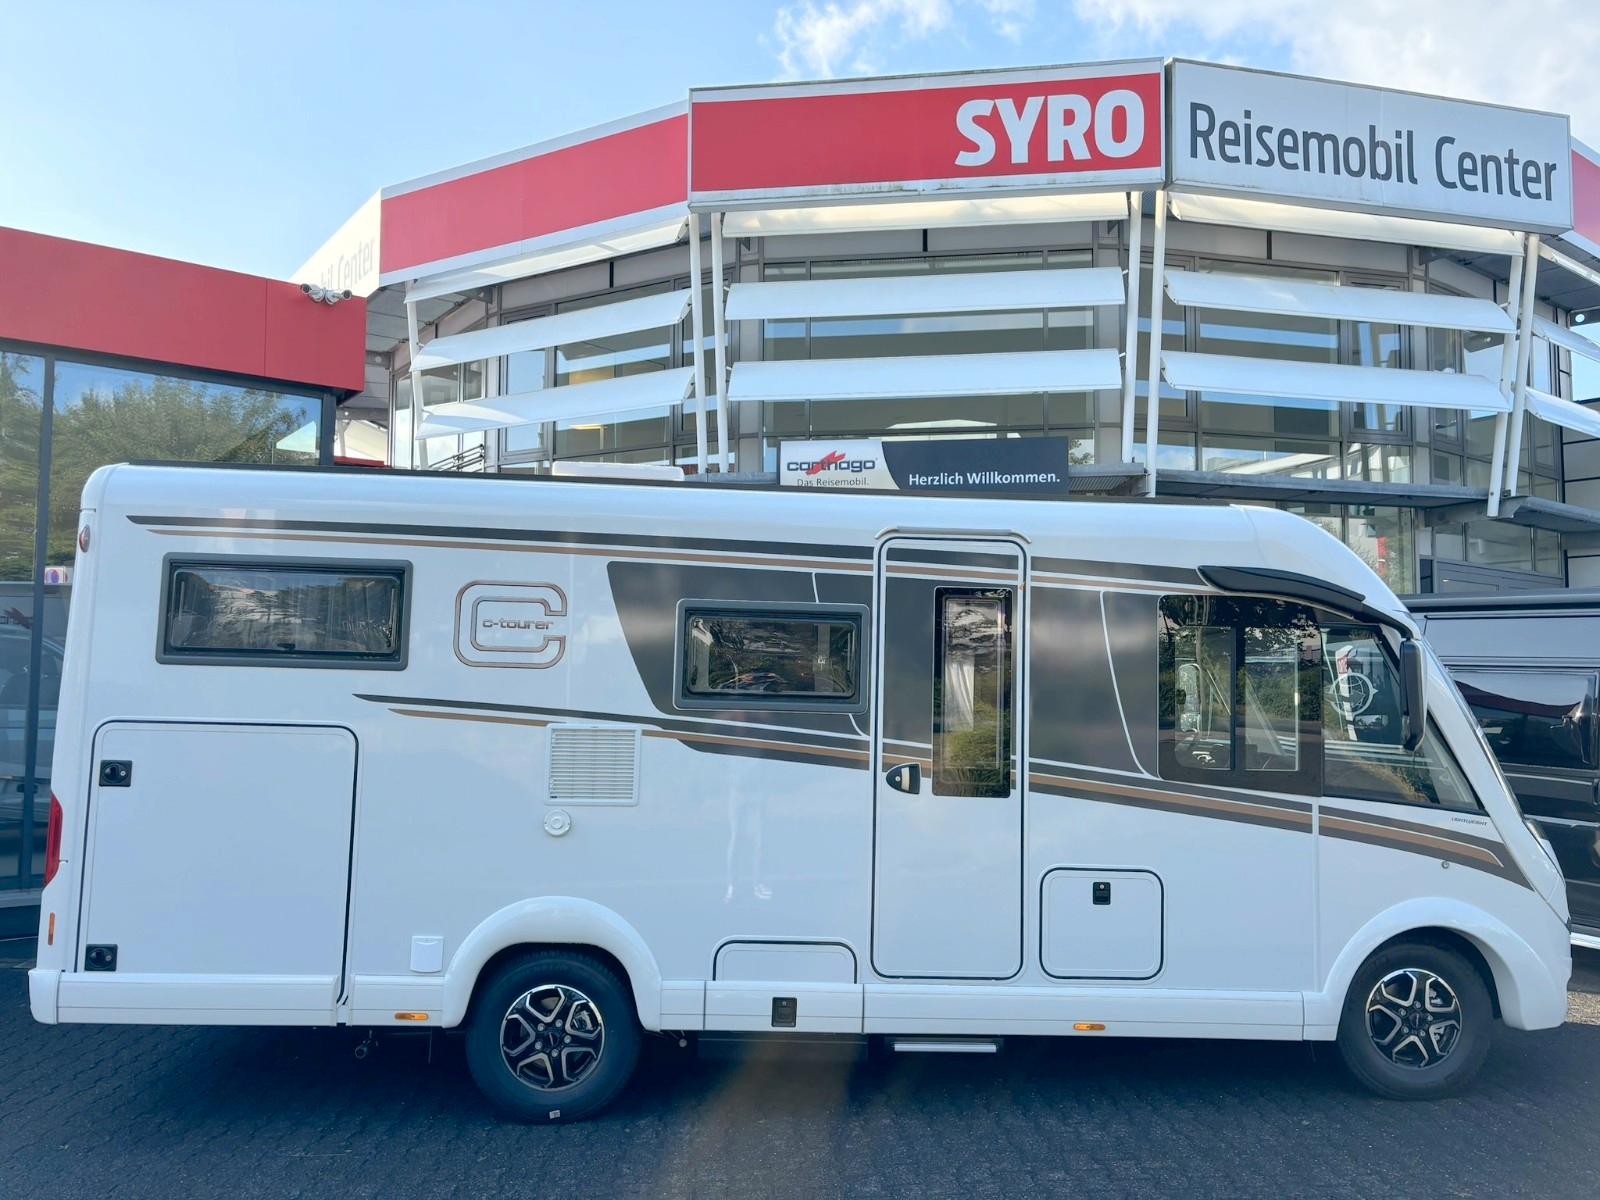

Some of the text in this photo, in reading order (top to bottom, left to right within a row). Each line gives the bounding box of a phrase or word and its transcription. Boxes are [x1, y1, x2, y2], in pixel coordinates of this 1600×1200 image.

[954, 89, 1145, 167] SYRO
[1189, 101, 1557, 201] Reisemobil Center
[797, 478, 814, 487] Das
[909, 471, 1061, 486] Herzlich Willkommen.
[482, 618, 554, 630] c-tourer
